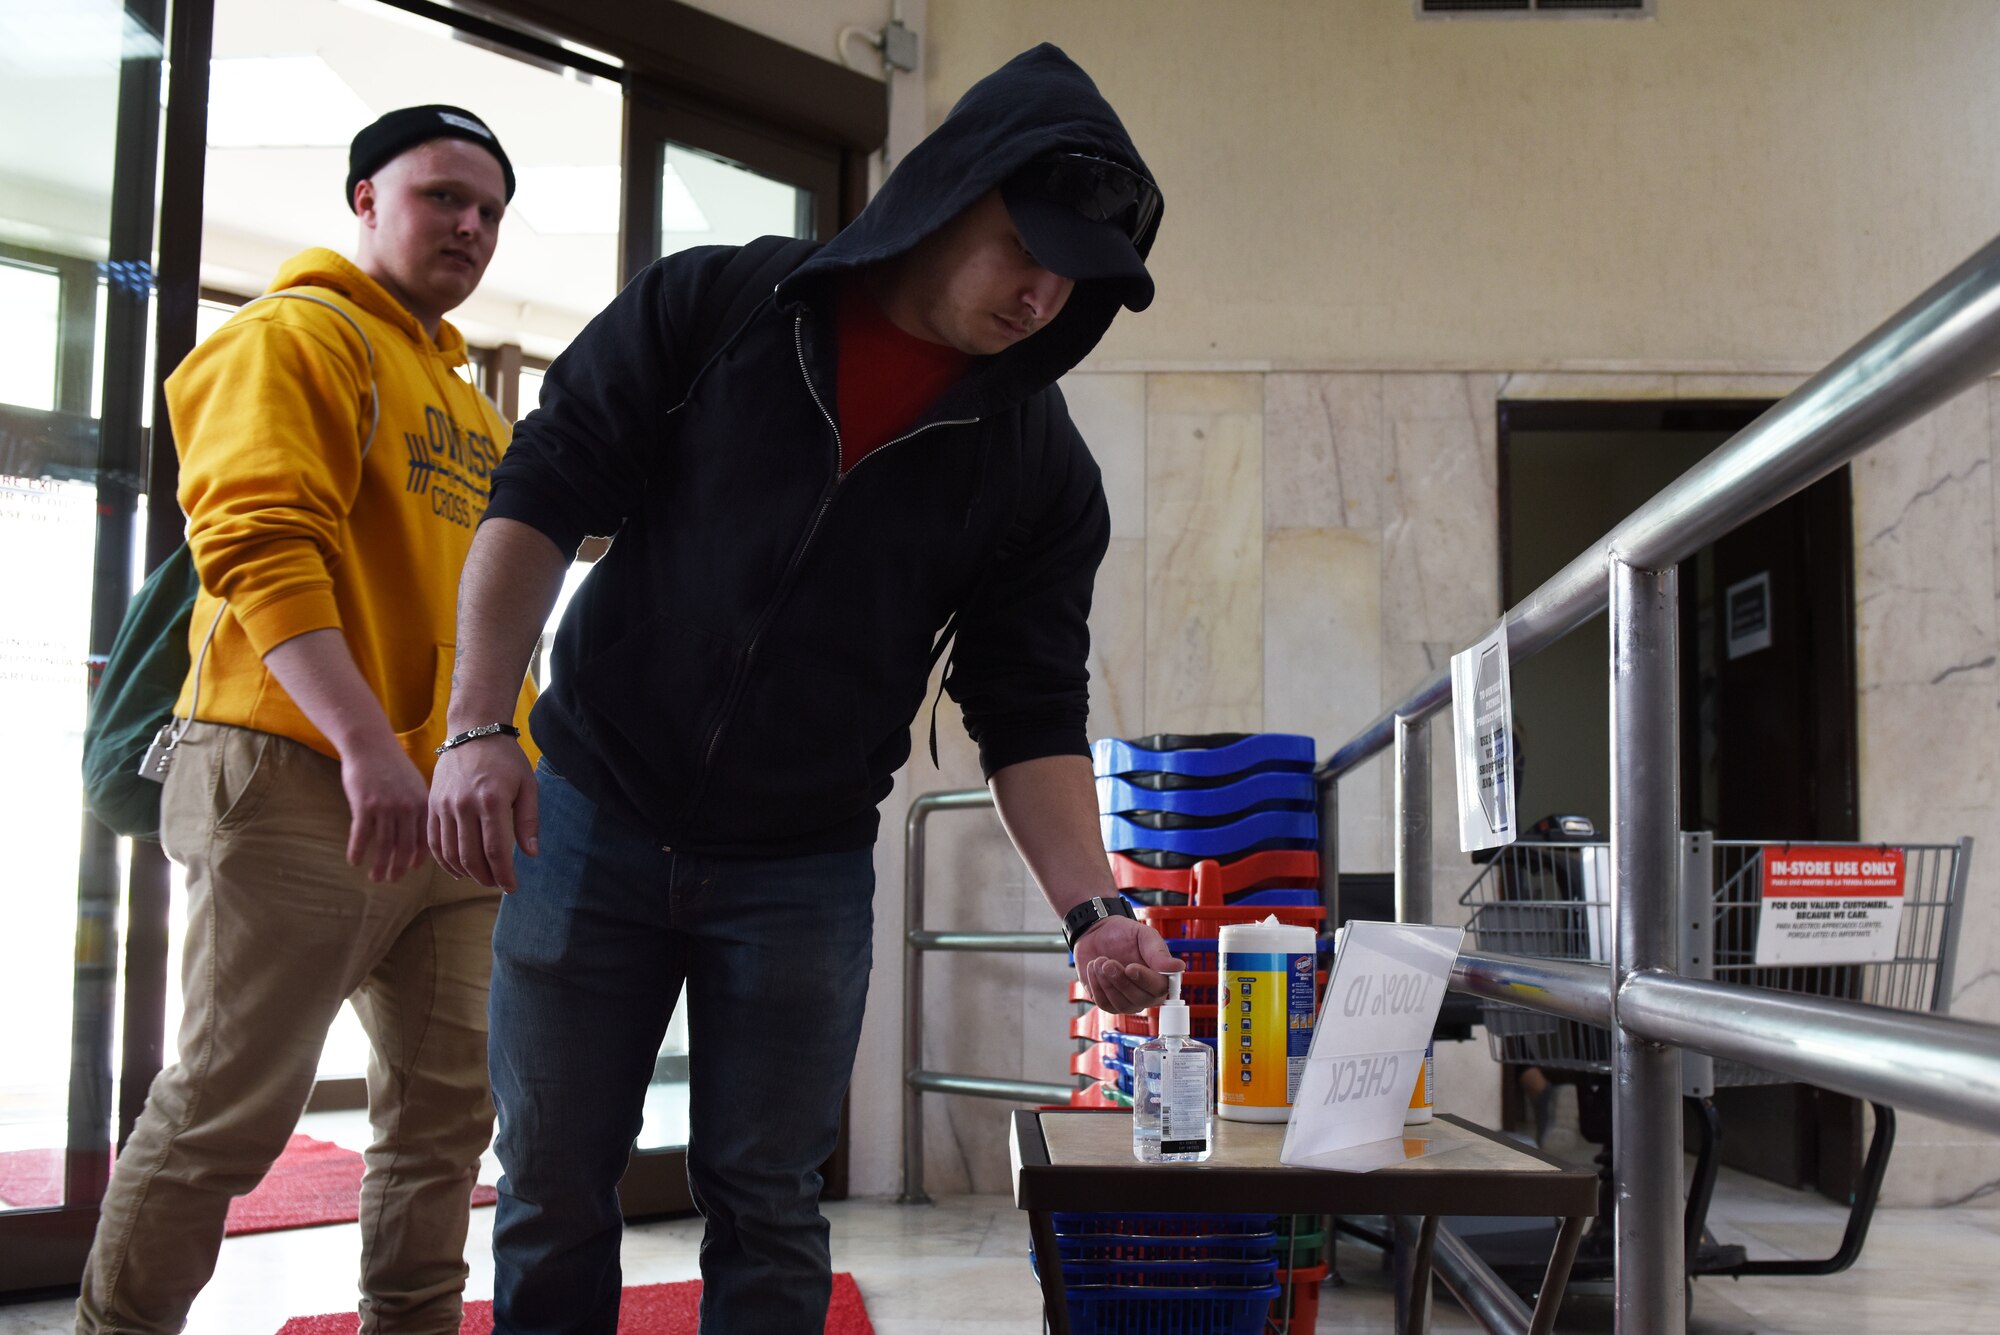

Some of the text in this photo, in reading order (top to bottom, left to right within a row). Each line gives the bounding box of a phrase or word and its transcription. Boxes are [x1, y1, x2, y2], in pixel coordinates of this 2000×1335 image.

[432, 485, 471, 528] CROSS
[1772, 861, 1896, 876] IN-STORE USE ONLY
[1771, 901, 1787, 910] FOR
[1790, 901, 1807, 909] OUR
[1810, 901, 1841, 909] VALUED
[1796, 911, 1869, 920] BECAUSE WE CARE.
